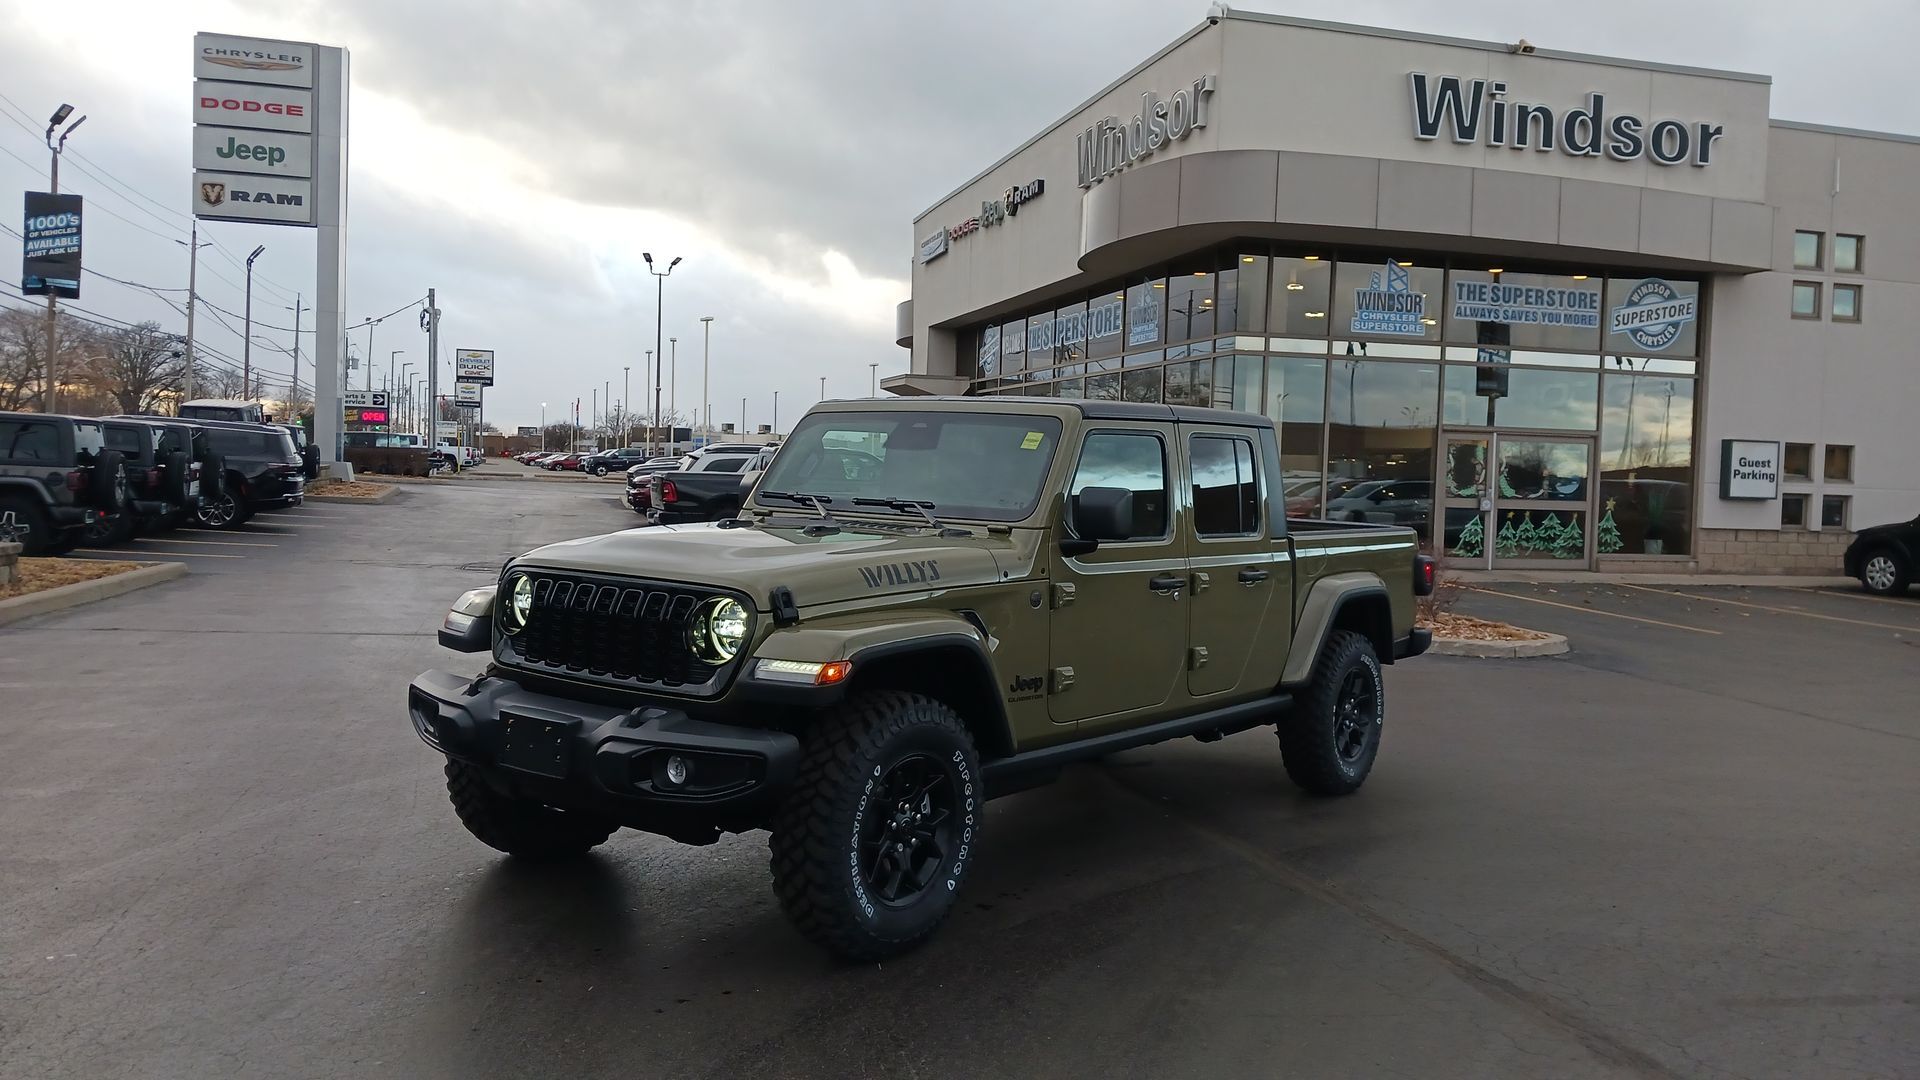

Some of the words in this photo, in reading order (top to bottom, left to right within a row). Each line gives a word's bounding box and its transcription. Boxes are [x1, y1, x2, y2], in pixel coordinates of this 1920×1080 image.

[203, 47, 302, 63] CHRYSLER
[201, 97, 303, 116] DODGE
[1408, 71, 1722, 166] Windsor
[1077, 74, 1216, 188] Windsor
[216, 137, 285, 166] Jeep
[230, 190, 302, 206] RAM
[1014, 179, 1044, 205] RAM
[41, 227, 77, 237] VEHICLES
[948, 217, 979, 240] DODGE
[27, 236, 79, 250] AVAILABLE
[27, 250, 46, 258] JUST
[49, 247, 65, 255] ASK
[1357, 292, 1422, 313] WINDSOR
[1456, 283, 1487, 301] THE
[1491, 286, 1598, 309] SUPERSTORE
[1632, 284, 1671, 302] WINDSOR
[1361, 312, 1416, 322] CHRYSLER
[1455, 306, 1500, 320] ALWAYS
[1503, 309, 1538, 322] SAVES
[1541, 311, 1561, 323] YOU
[1563, 313, 1597, 326] MORE!
[1615, 303, 1693, 327] SUPERSTORE
[1028, 325, 1041, 350] THE
[1042, 303, 1121, 350] SUPERSTORE
[1354, 321, 1423, 332] SUPERSTORE
[1637, 325, 1676, 345] CHRYSLER
[362, 412, 385, 421] OPEN
[1739, 456, 1771, 468] Guest
[1733, 469, 1775, 483] Parking
[857, 559, 940, 588] WILLYS
[1010, 674, 1043, 693] Jeep
[850, 778, 875, 919] DESTINATION
